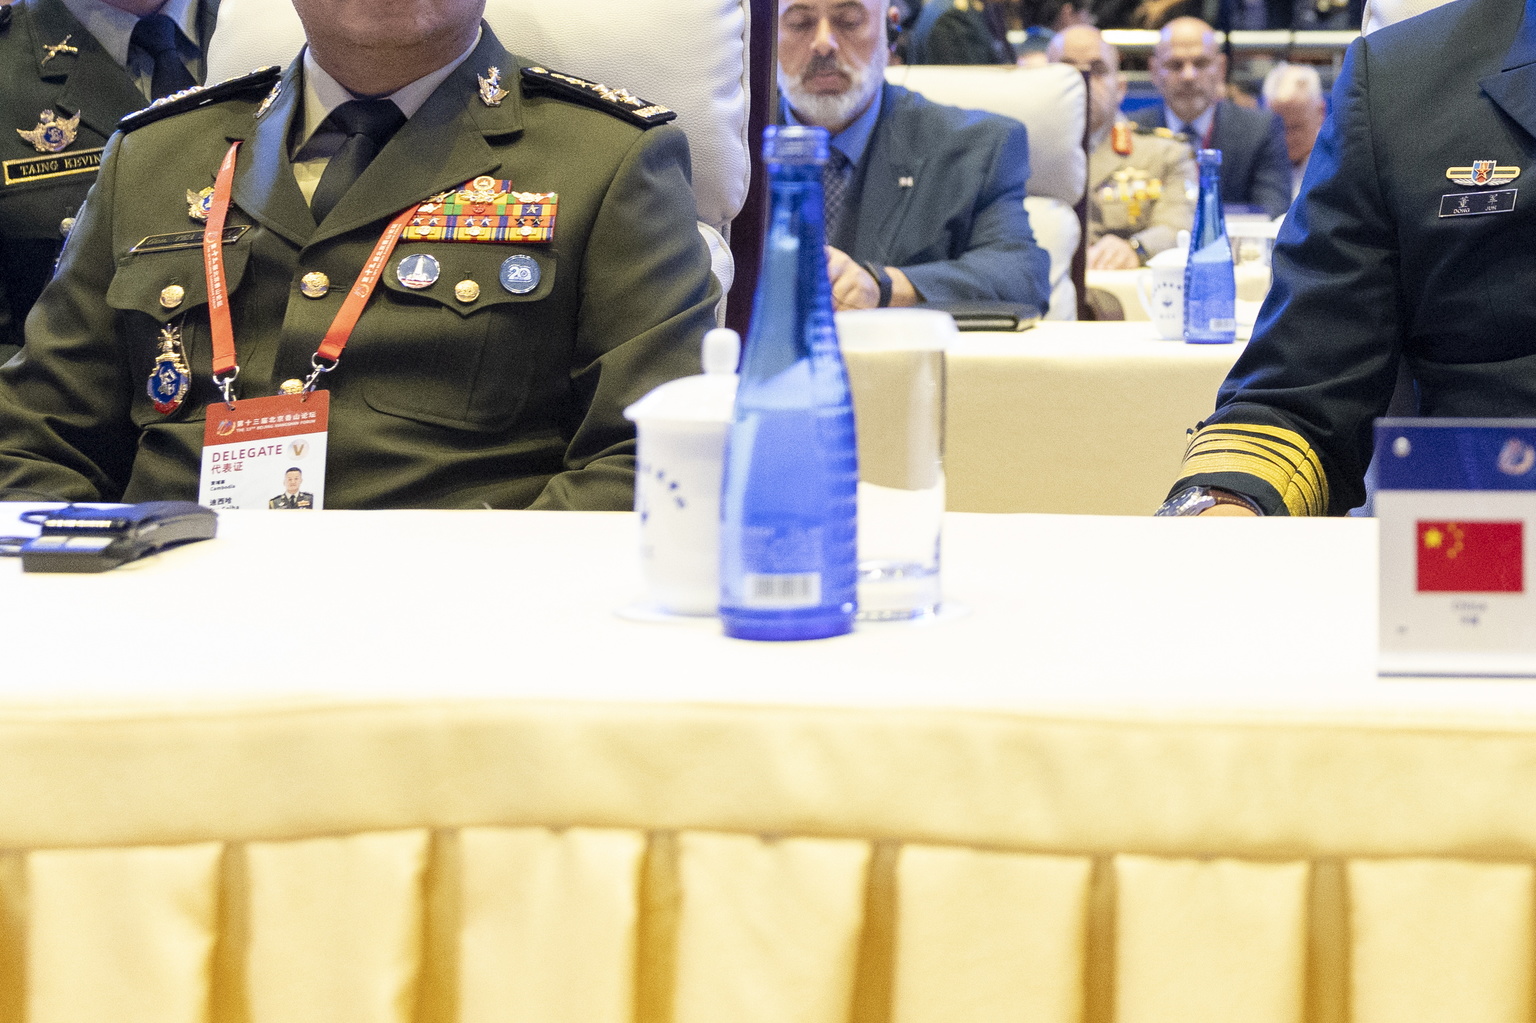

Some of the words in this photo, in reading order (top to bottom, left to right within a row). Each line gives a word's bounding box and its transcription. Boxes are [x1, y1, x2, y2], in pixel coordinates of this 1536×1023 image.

[20, 160, 59, 176] TAING
[64, 152, 102, 169] KEVIN
[212, 445, 283, 463] DELEGATE
[293, 444, 305, 456] V
[211, 462, 244, 474] 代表证
